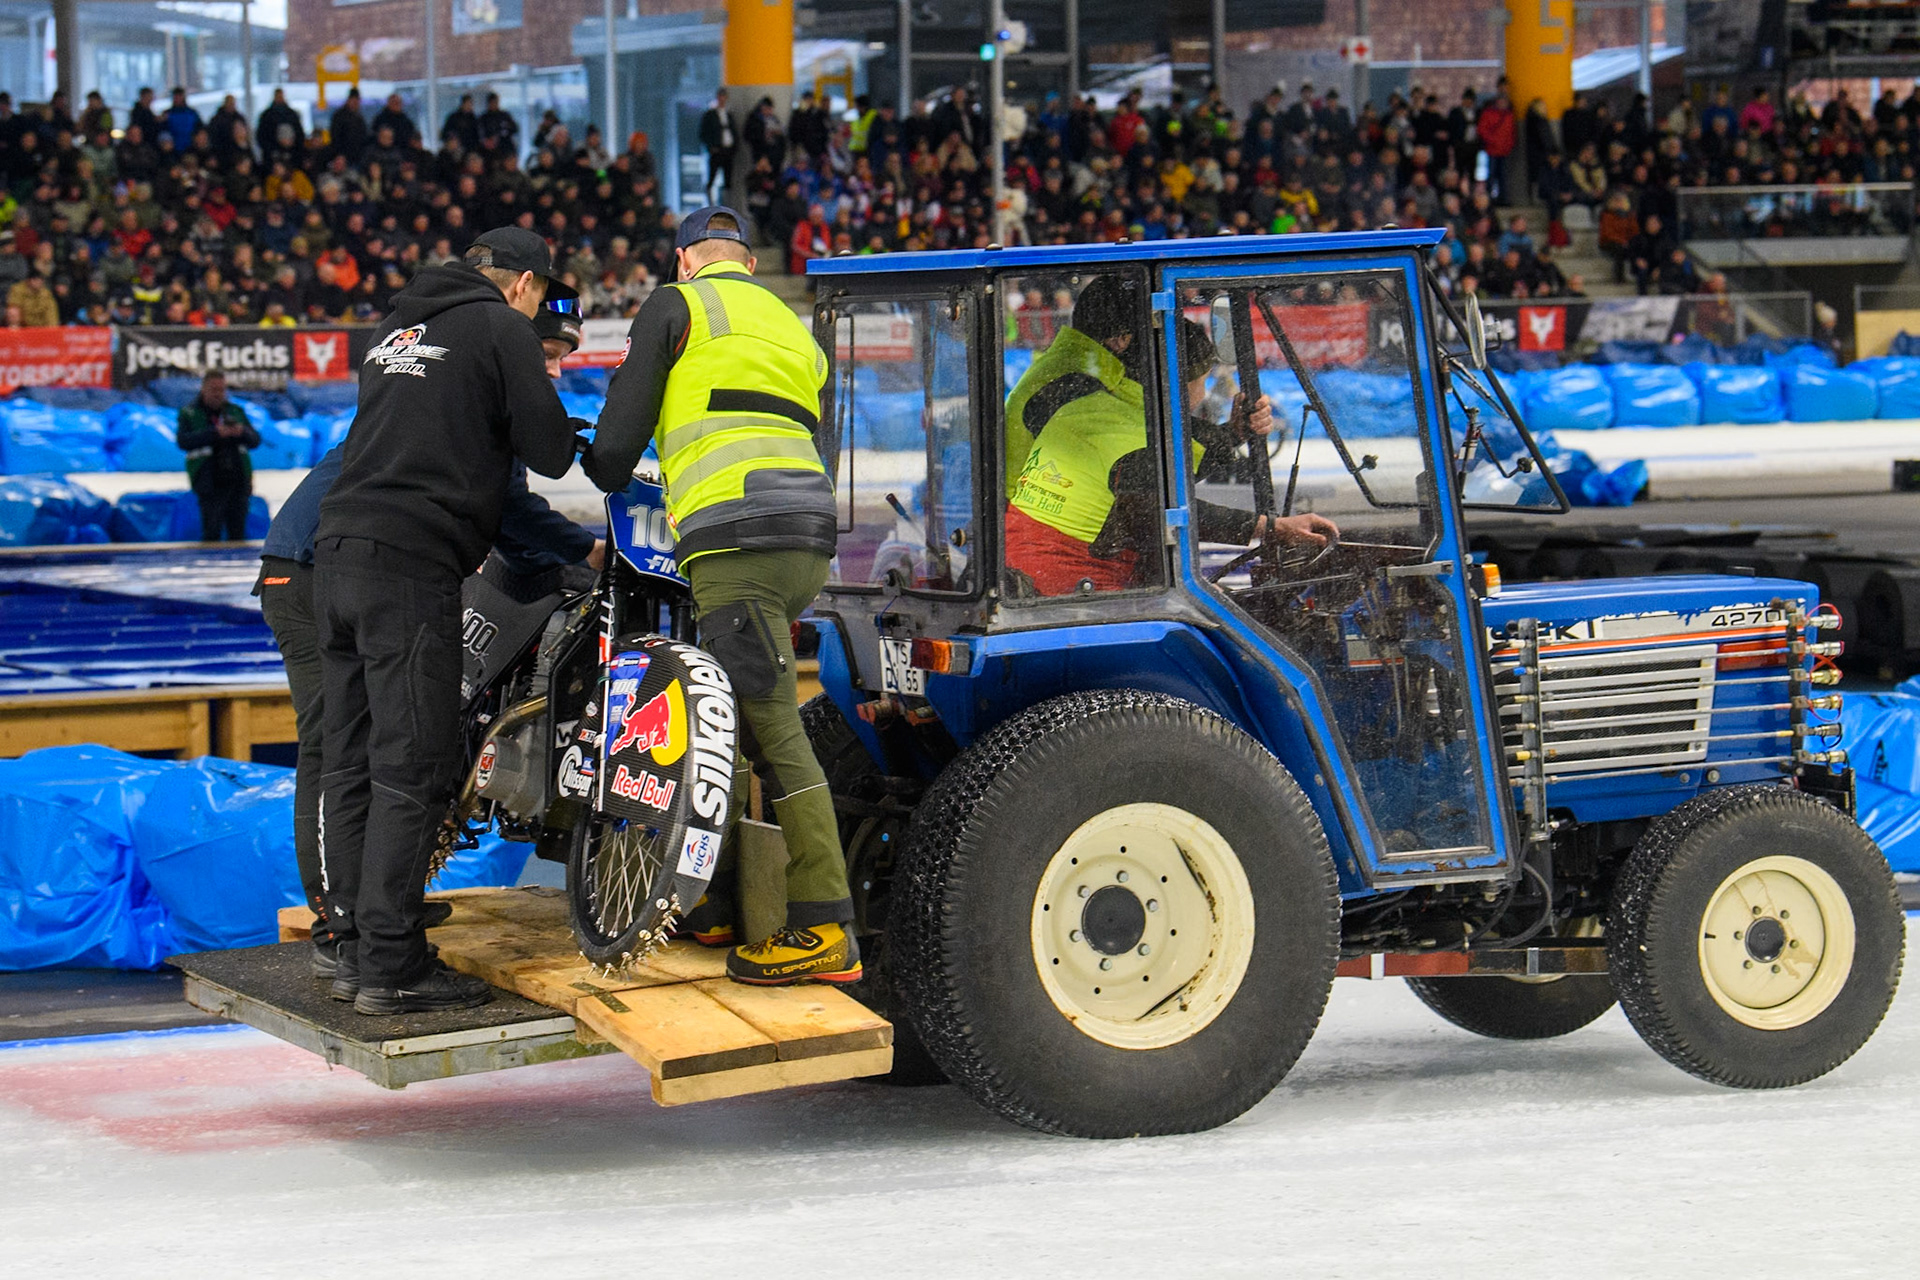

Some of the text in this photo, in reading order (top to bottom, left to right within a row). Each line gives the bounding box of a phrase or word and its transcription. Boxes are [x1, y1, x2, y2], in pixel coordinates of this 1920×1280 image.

[125, 338, 289, 375] Josef Fuchs
[1711, 609, 1783, 628] 4270
[893, 642, 908, 665] TS
[905, 669, 919, 691] 55
[611, 764, 677, 812] Red Bull
[693, 834, 710, 875] FUCHS
[762, 953, 842, 976] LA SPORTIVA
